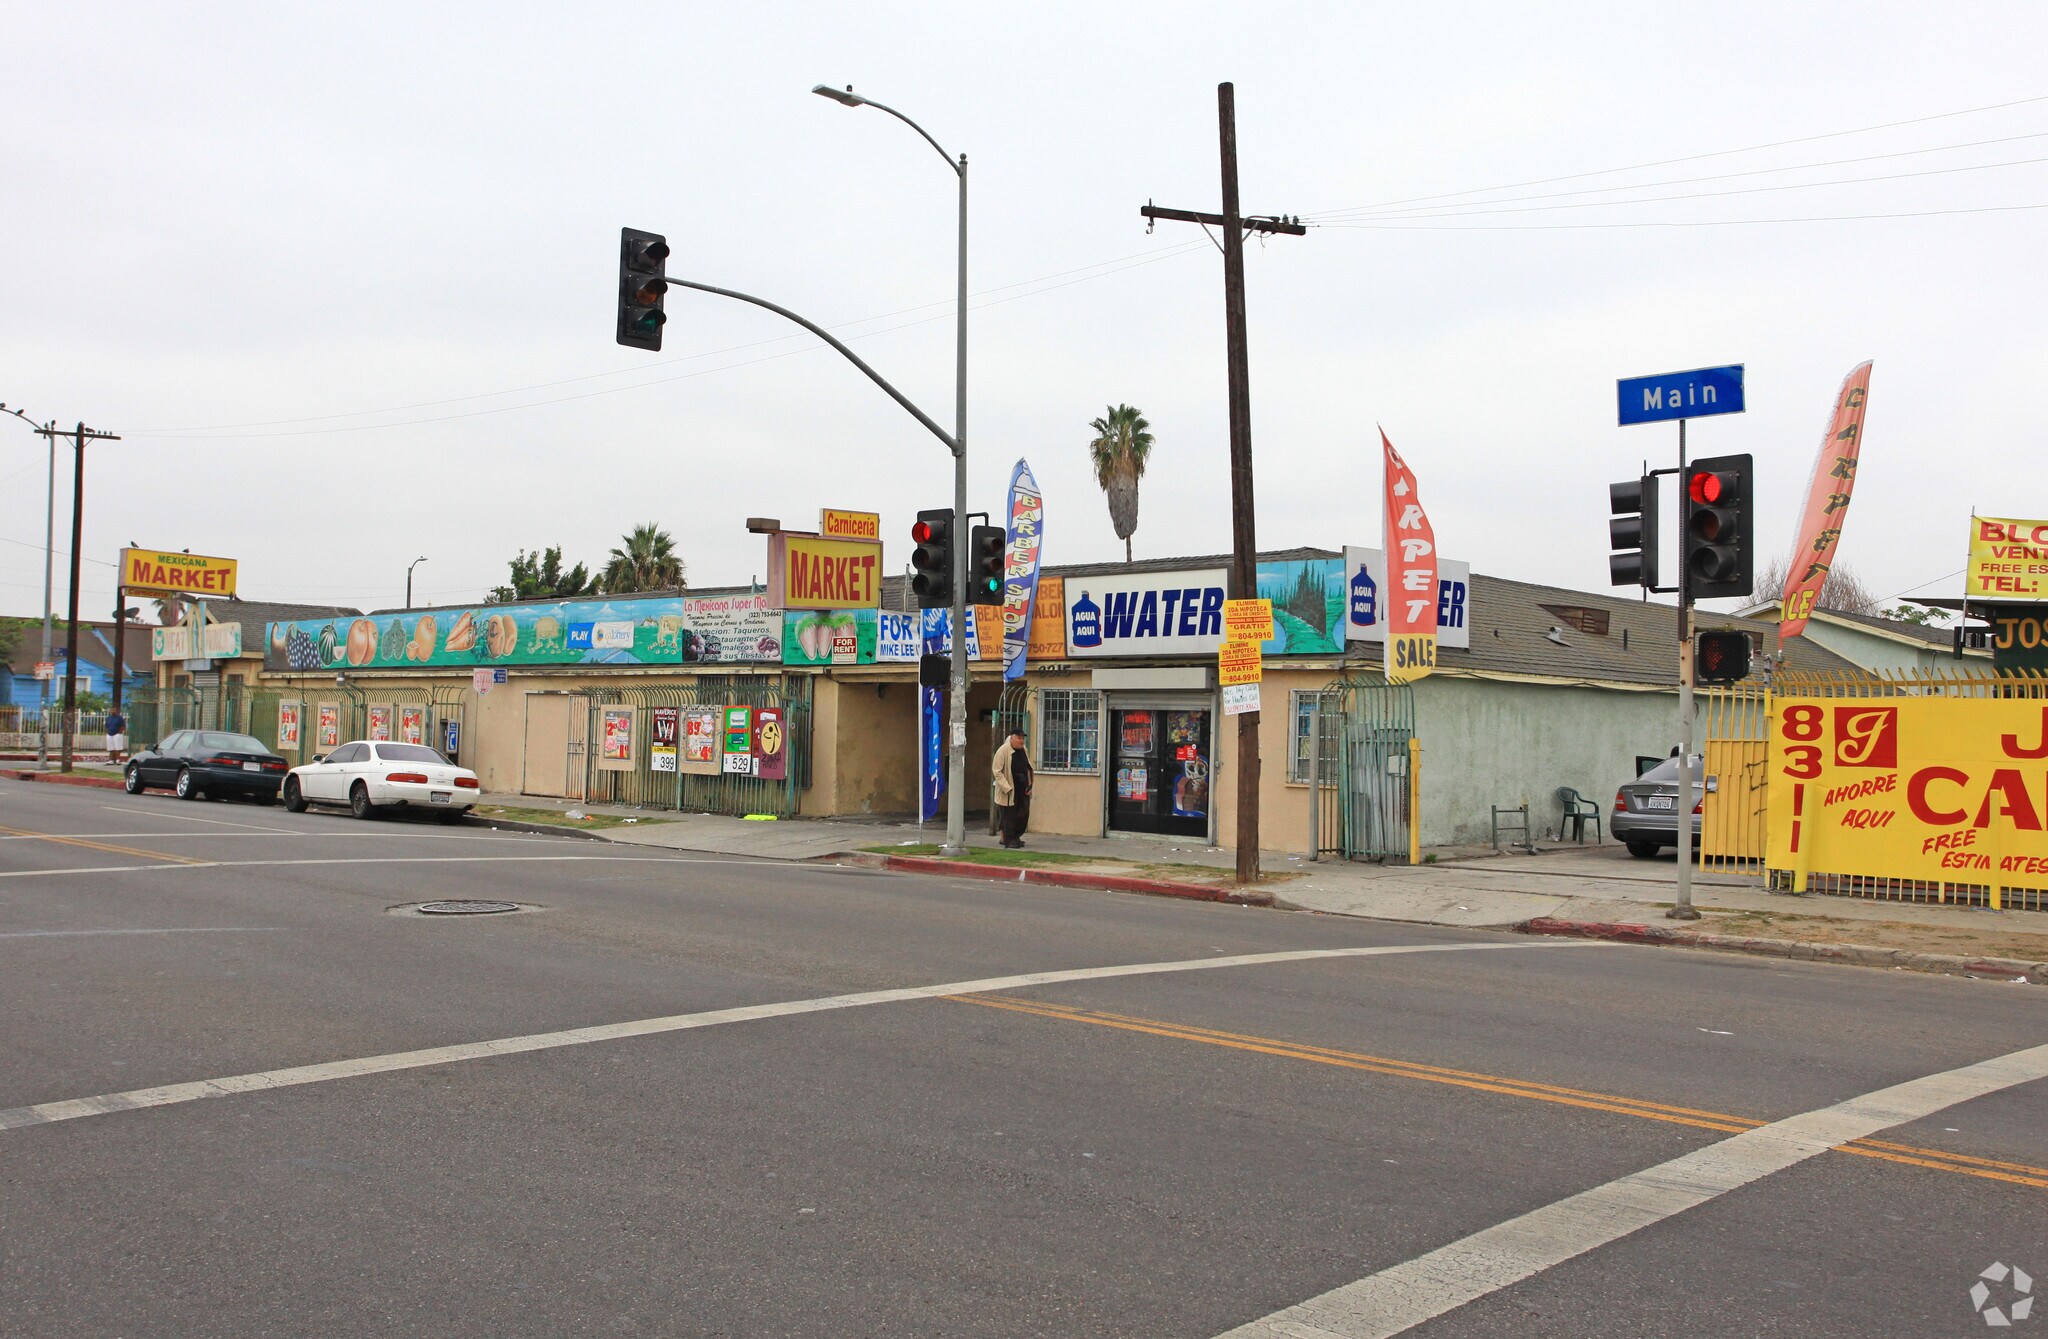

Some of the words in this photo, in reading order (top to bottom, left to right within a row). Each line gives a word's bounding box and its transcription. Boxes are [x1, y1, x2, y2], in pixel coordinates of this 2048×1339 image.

[1643, 382, 1717, 411] Main
[1801, 387, 1864, 583] CARPET
[1008, 495, 1037, 577] BARBER
[1388, 446, 1433, 623] CARPET
[157, 555, 207, 567] MEXICANA
[1991, 545, 2048, 560] VENT
[132, 559, 231, 590] MARKET
[790, 550, 876, 602] MARKET
[1980, 563, 2022, 574] FREE
[2028, 564, 2048, 575] ES
[1353, 586, 1373, 598] AGUA
[1978, 575, 2038, 593] TEL:
[694, 599, 729, 613] Mexicana
[753, 596, 767, 610] Ma
[1003, 583, 1023, 636] SHOP
[1103, 587, 1225, 638] WATER
[1354, 602, 1371, 614] AQUI
[1075, 611, 1096, 622] AGUA
[571, 631, 589, 641] PLAY
[880, 615, 913, 642] FOR
[1076, 626, 1095, 636] AQUI
[836, 638, 853, 646] FOR
[880, 643, 900, 656] MIKE
[901, 643, 914, 656] LEE
[1396, 637, 1433, 669] SALE
[1229, 674, 1259, 682] 804-9910
[2001, 706, 2048, 759] J
[1824, 774, 1898, 807] AHORRE
[1907, 766, 2048, 831] CA
[1841, 809, 1895, 829] AQUI
[1922, 829, 1977, 855] FREE
